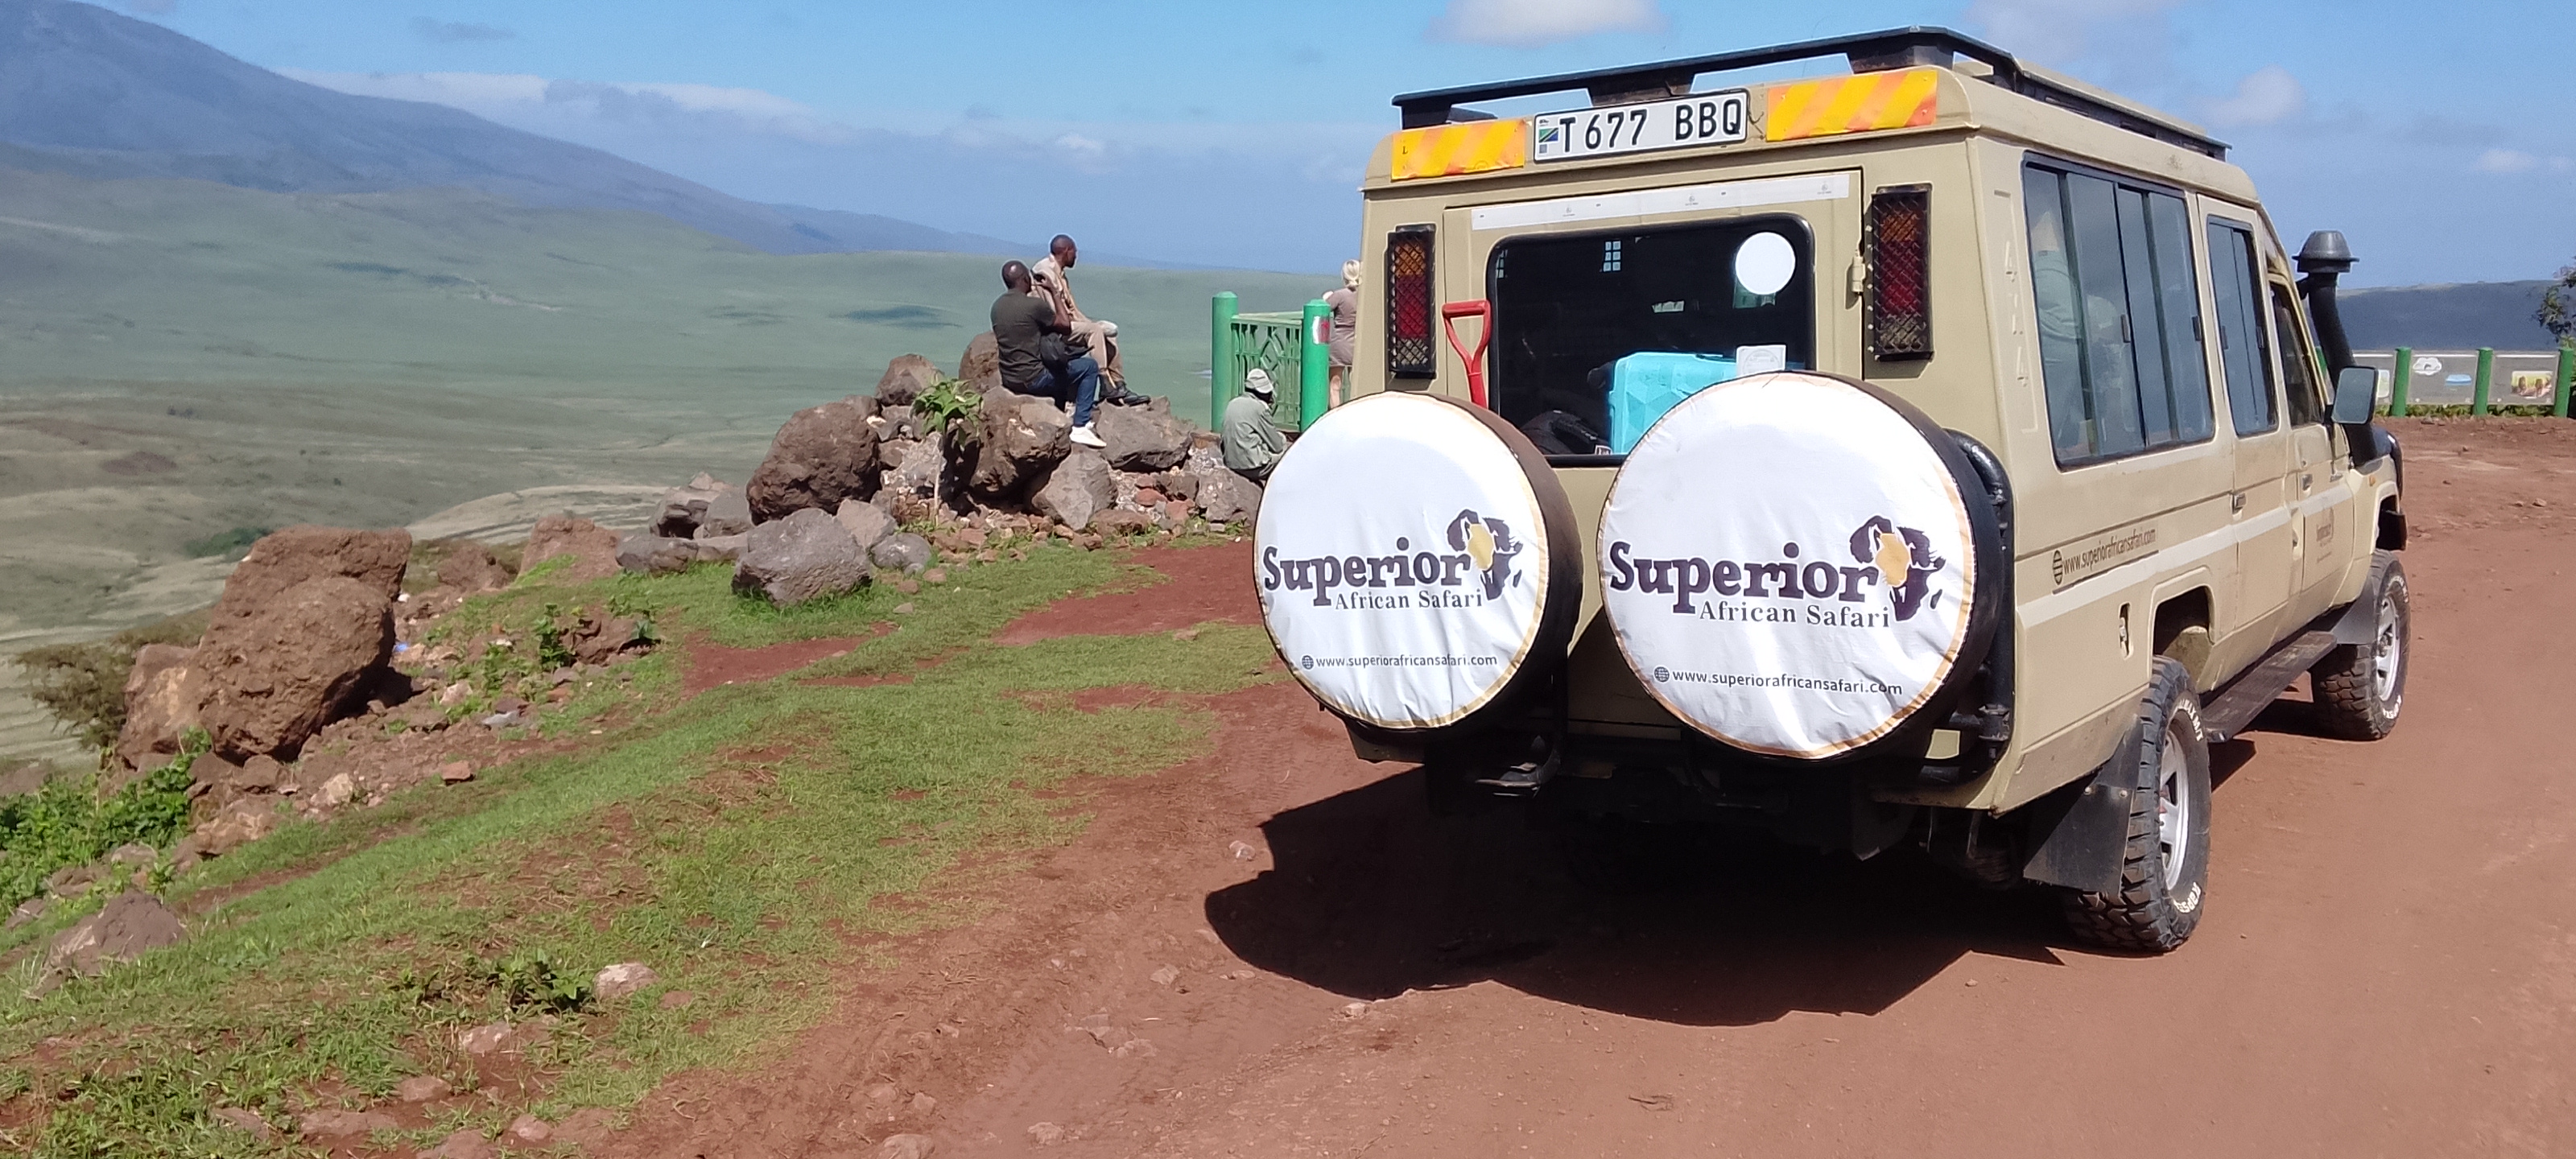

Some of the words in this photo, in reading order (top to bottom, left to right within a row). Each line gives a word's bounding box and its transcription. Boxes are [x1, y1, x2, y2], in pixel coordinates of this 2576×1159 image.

[1558, 117, 1576, 153] T
[1584, 108, 1648, 150] 677
[1674, 98, 1742, 141] BBQ
[1262, 536, 1472, 607] Superior
[1609, 541, 1880, 614] Superior
[1335, 590, 1410, 610] African
[1418, 588, 1482, 608] Safari
[1699, 600, 1797, 624] African
[1806, 604, 1889, 628] Safari
[1316, 654, 1498, 668] www.superiorafricansafari.com
[1672, 669, 1903, 695] www.superiorafricansafari.com
